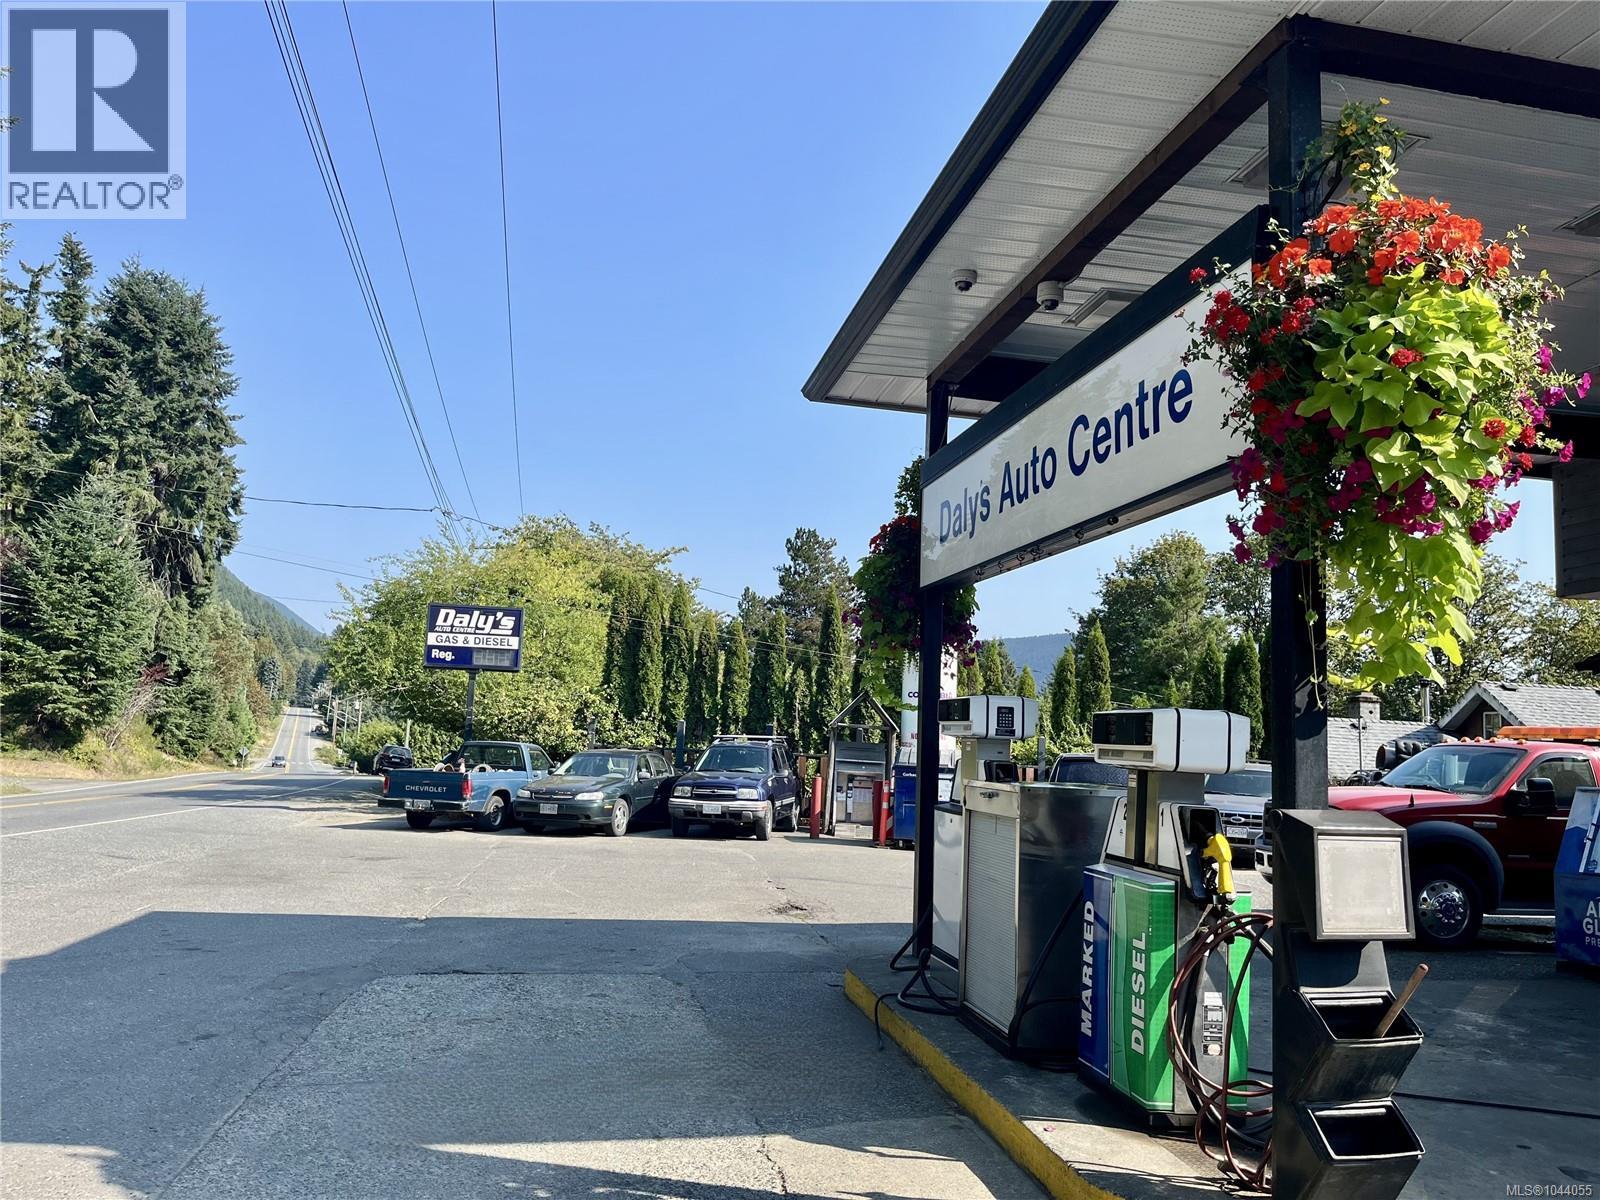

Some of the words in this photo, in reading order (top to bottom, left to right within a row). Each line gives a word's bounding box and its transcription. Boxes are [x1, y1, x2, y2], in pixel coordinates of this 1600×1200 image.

[939, 480, 991, 544] Daly's
[999, 445, 1057, 513] Auto
[1068, 369, 1193, 477] Centre
[435, 609, 516, 634] Daly's
[436, 635, 459, 645] GAS
[462, 636, 470, 645] &
[474, 637, 513, 647] DIESEL
[431, 649, 455, 661] Reg.
[405, 785, 447, 793] CHEVROLET
[1080, 901, 1095, 1037] MARKED
[1131, 932, 1146, 1055] DIESEL
